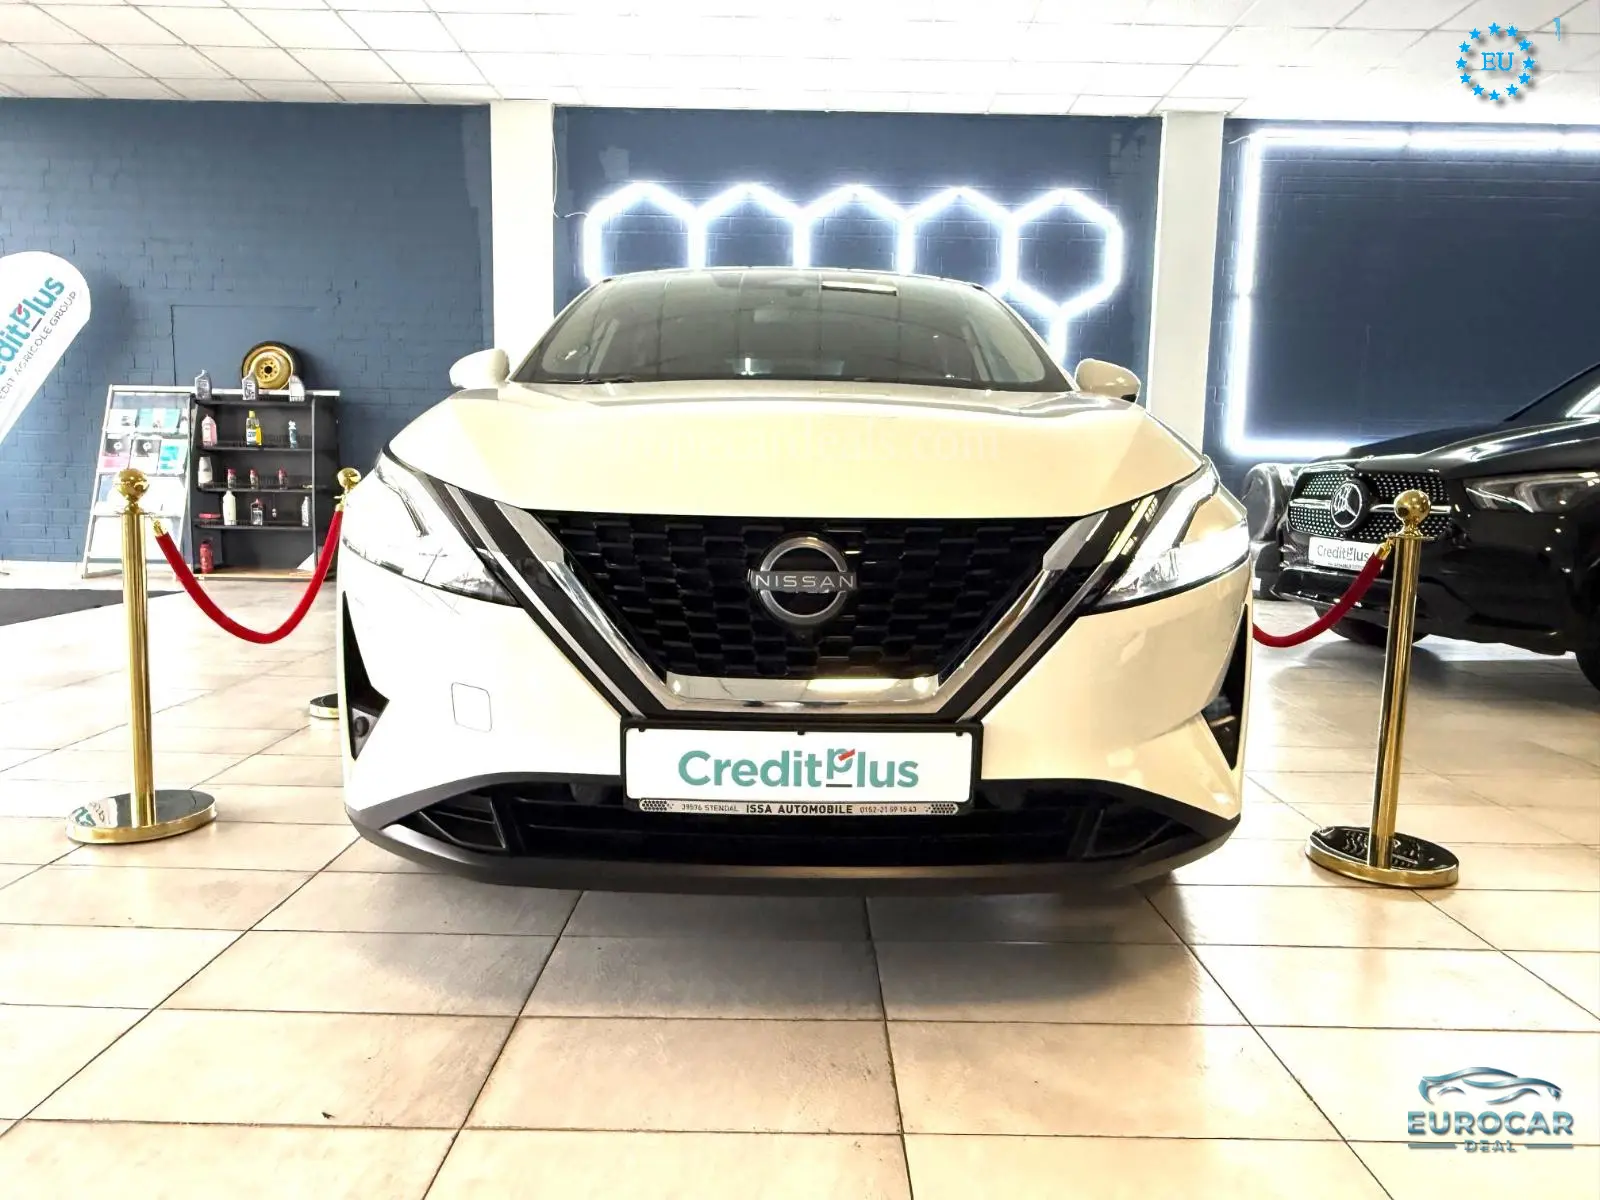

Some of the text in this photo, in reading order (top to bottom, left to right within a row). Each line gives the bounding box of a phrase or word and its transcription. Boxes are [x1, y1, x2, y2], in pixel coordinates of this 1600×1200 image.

[50, 291, 77, 327] GROUP
[755, 574, 854, 588] NISSAN
[678, 748, 919, 788] CreditPlus
[704, 804, 739, 812] STENDAL
[746, 803, 773, 814] ISSA
[777, 804, 853, 815] AUTOMOBILE
